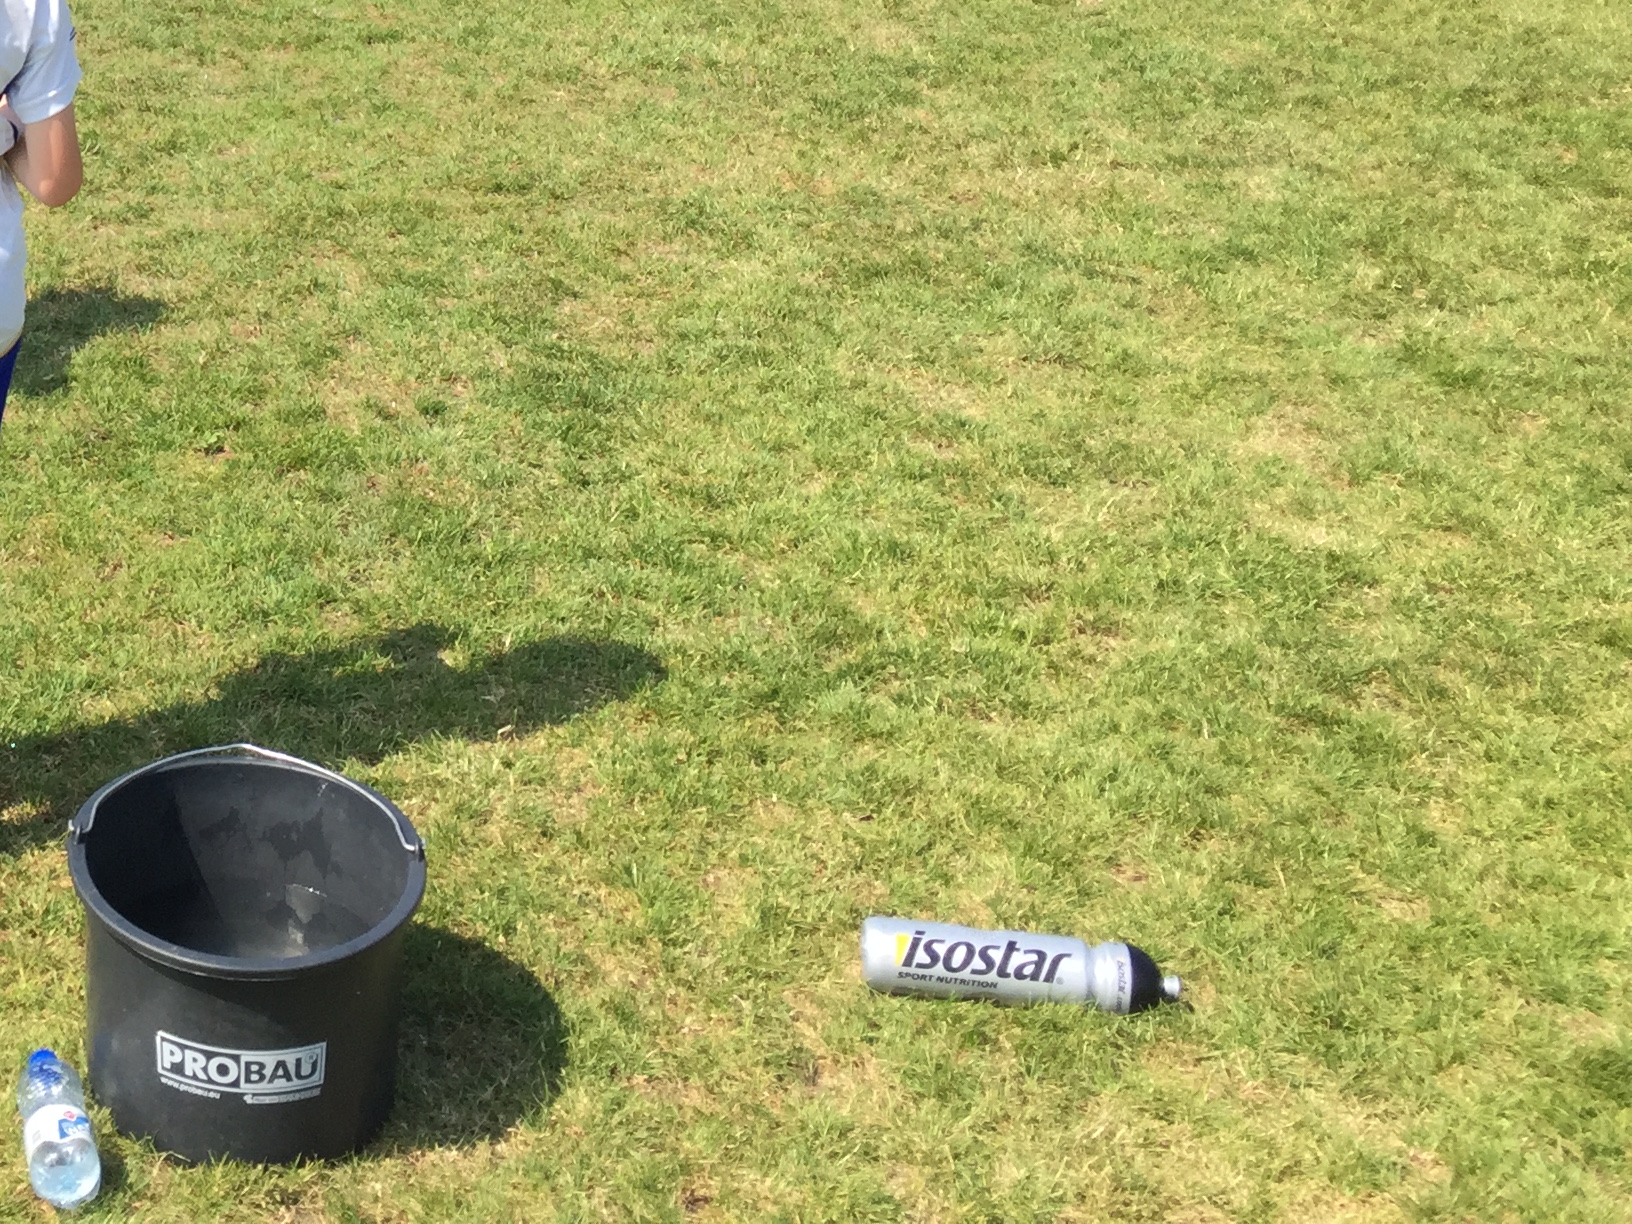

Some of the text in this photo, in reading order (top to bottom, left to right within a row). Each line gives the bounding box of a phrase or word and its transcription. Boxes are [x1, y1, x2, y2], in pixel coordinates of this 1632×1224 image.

[901, 930, 1073, 984] isostar
[897, 971, 999, 989] SPORT NUTRITION
[162, 1041, 318, 1084] PROBAU
